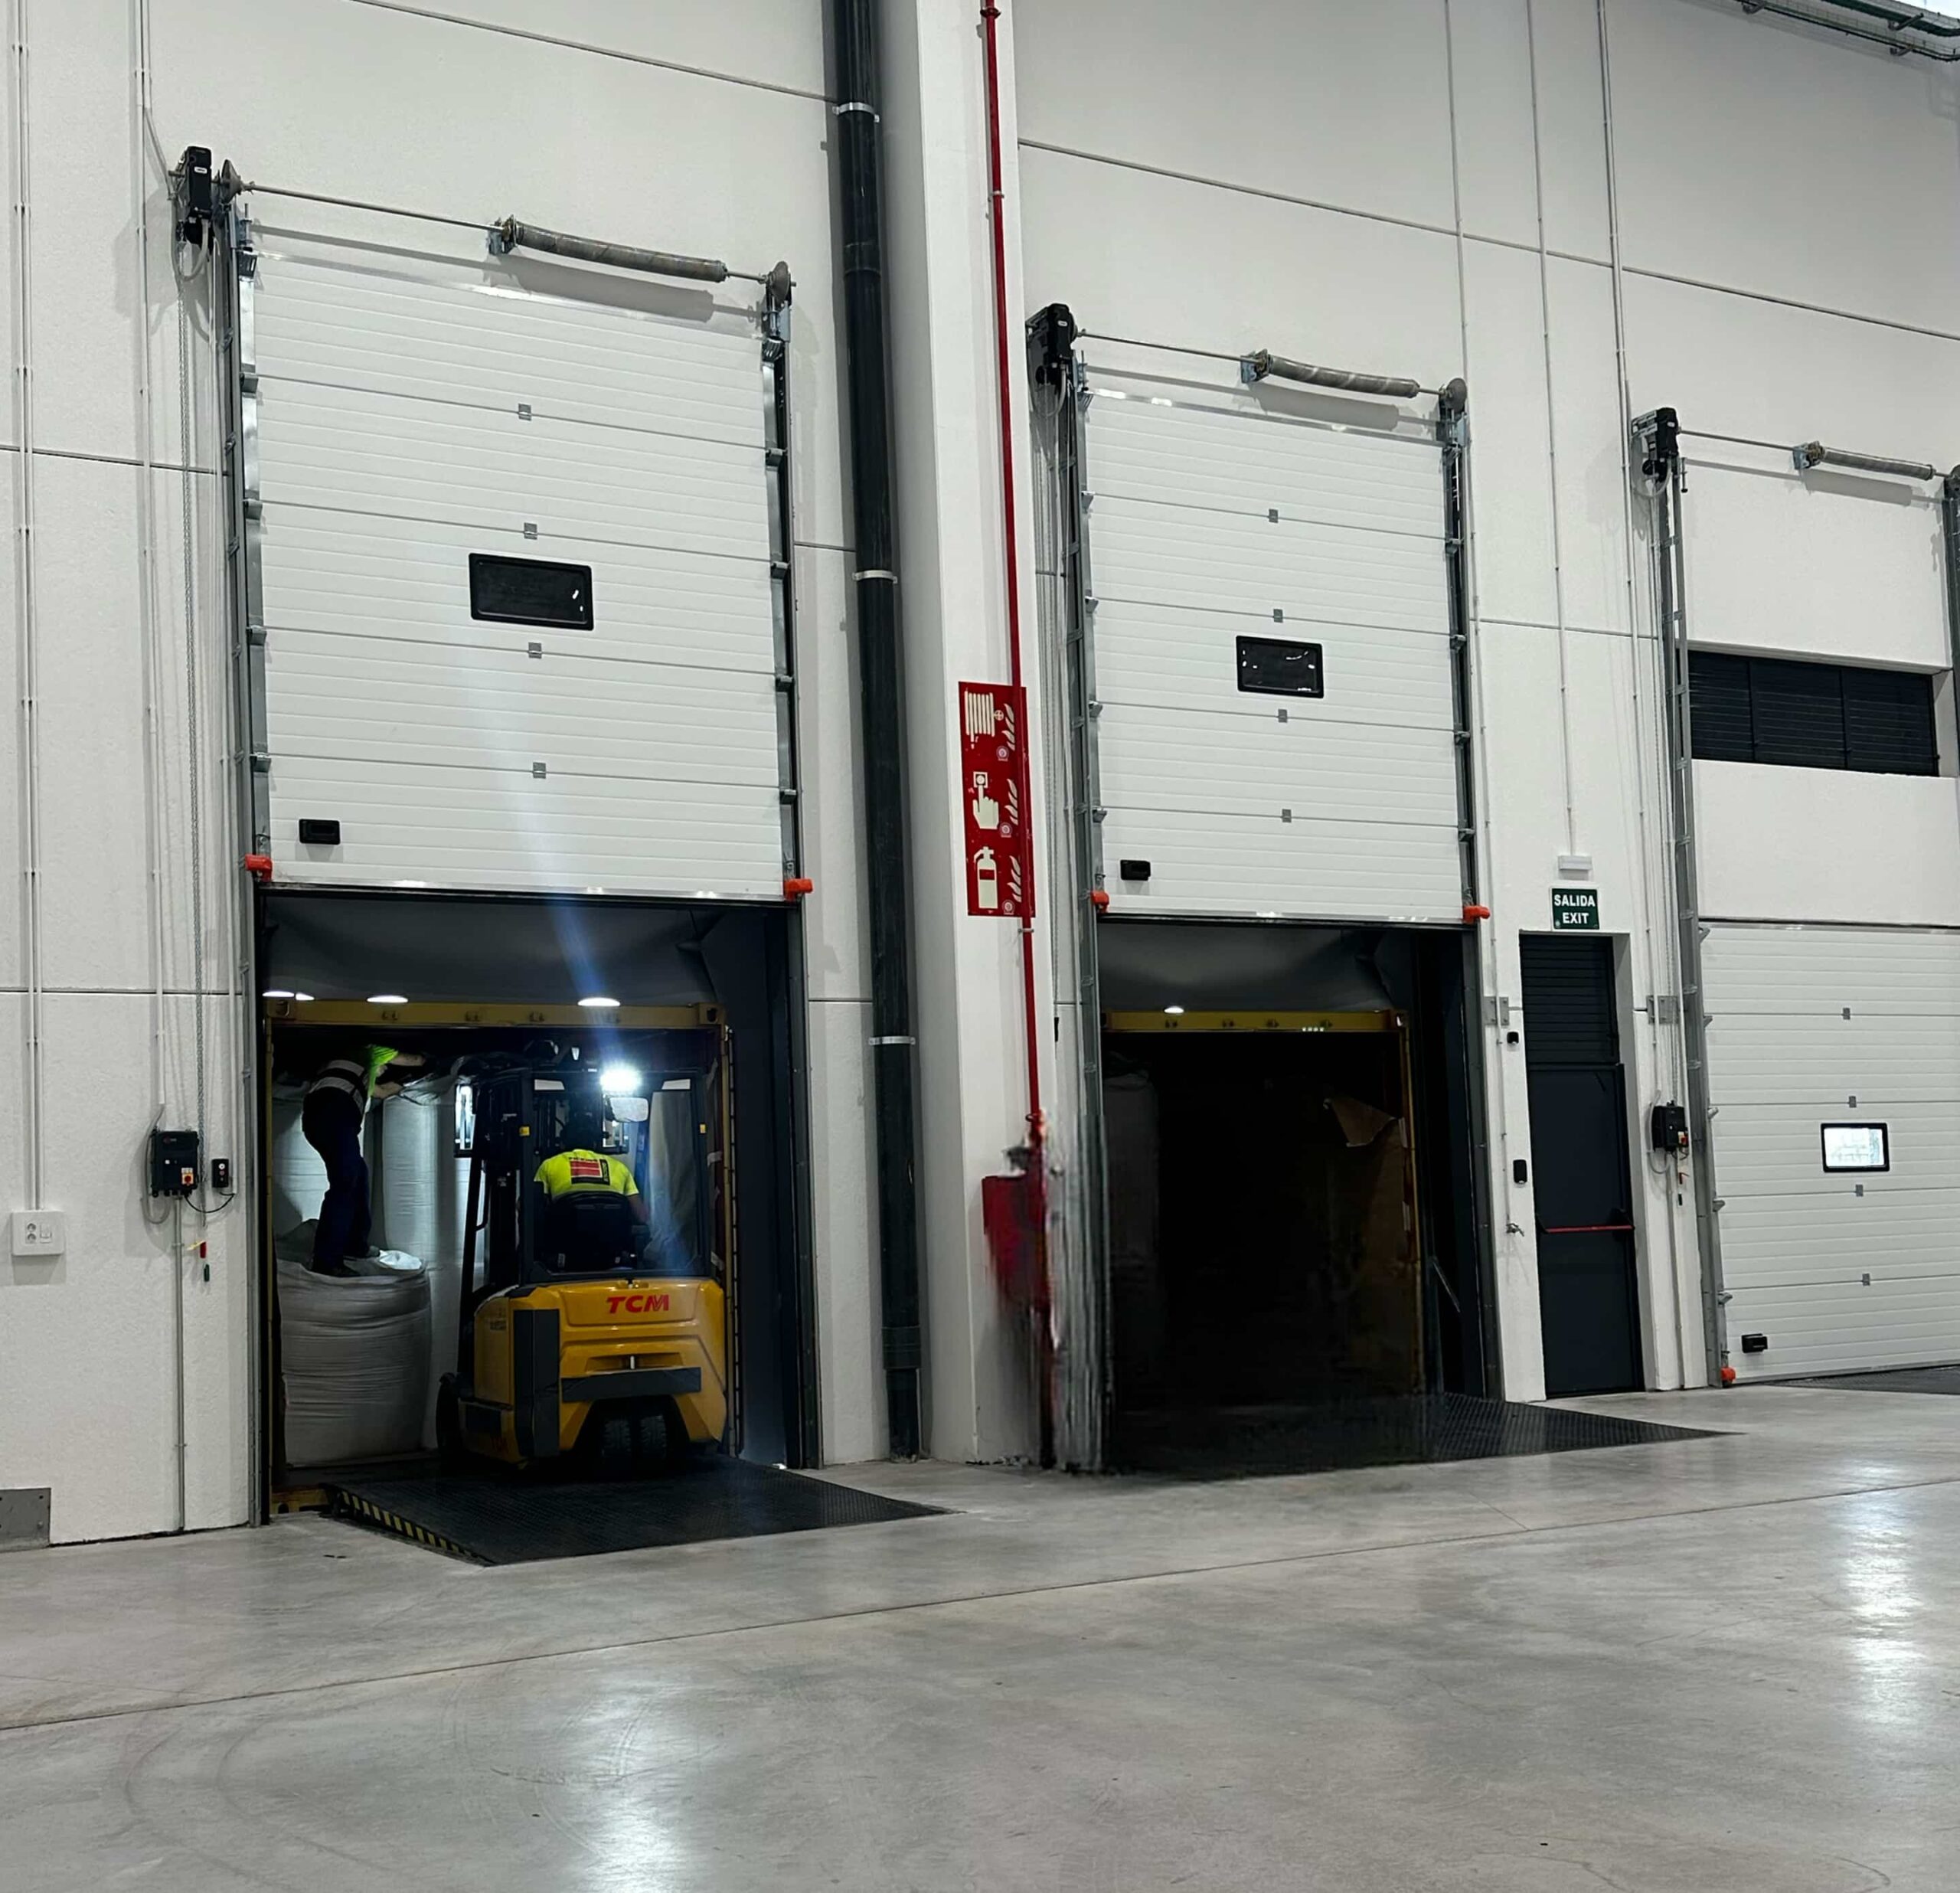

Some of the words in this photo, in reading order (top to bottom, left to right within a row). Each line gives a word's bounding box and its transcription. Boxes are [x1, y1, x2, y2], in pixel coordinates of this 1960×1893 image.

[1553, 894, 1596, 907] SALIDA
[1562, 912, 1589, 924] EXIT
[606, 1294, 669, 1314] TCM
